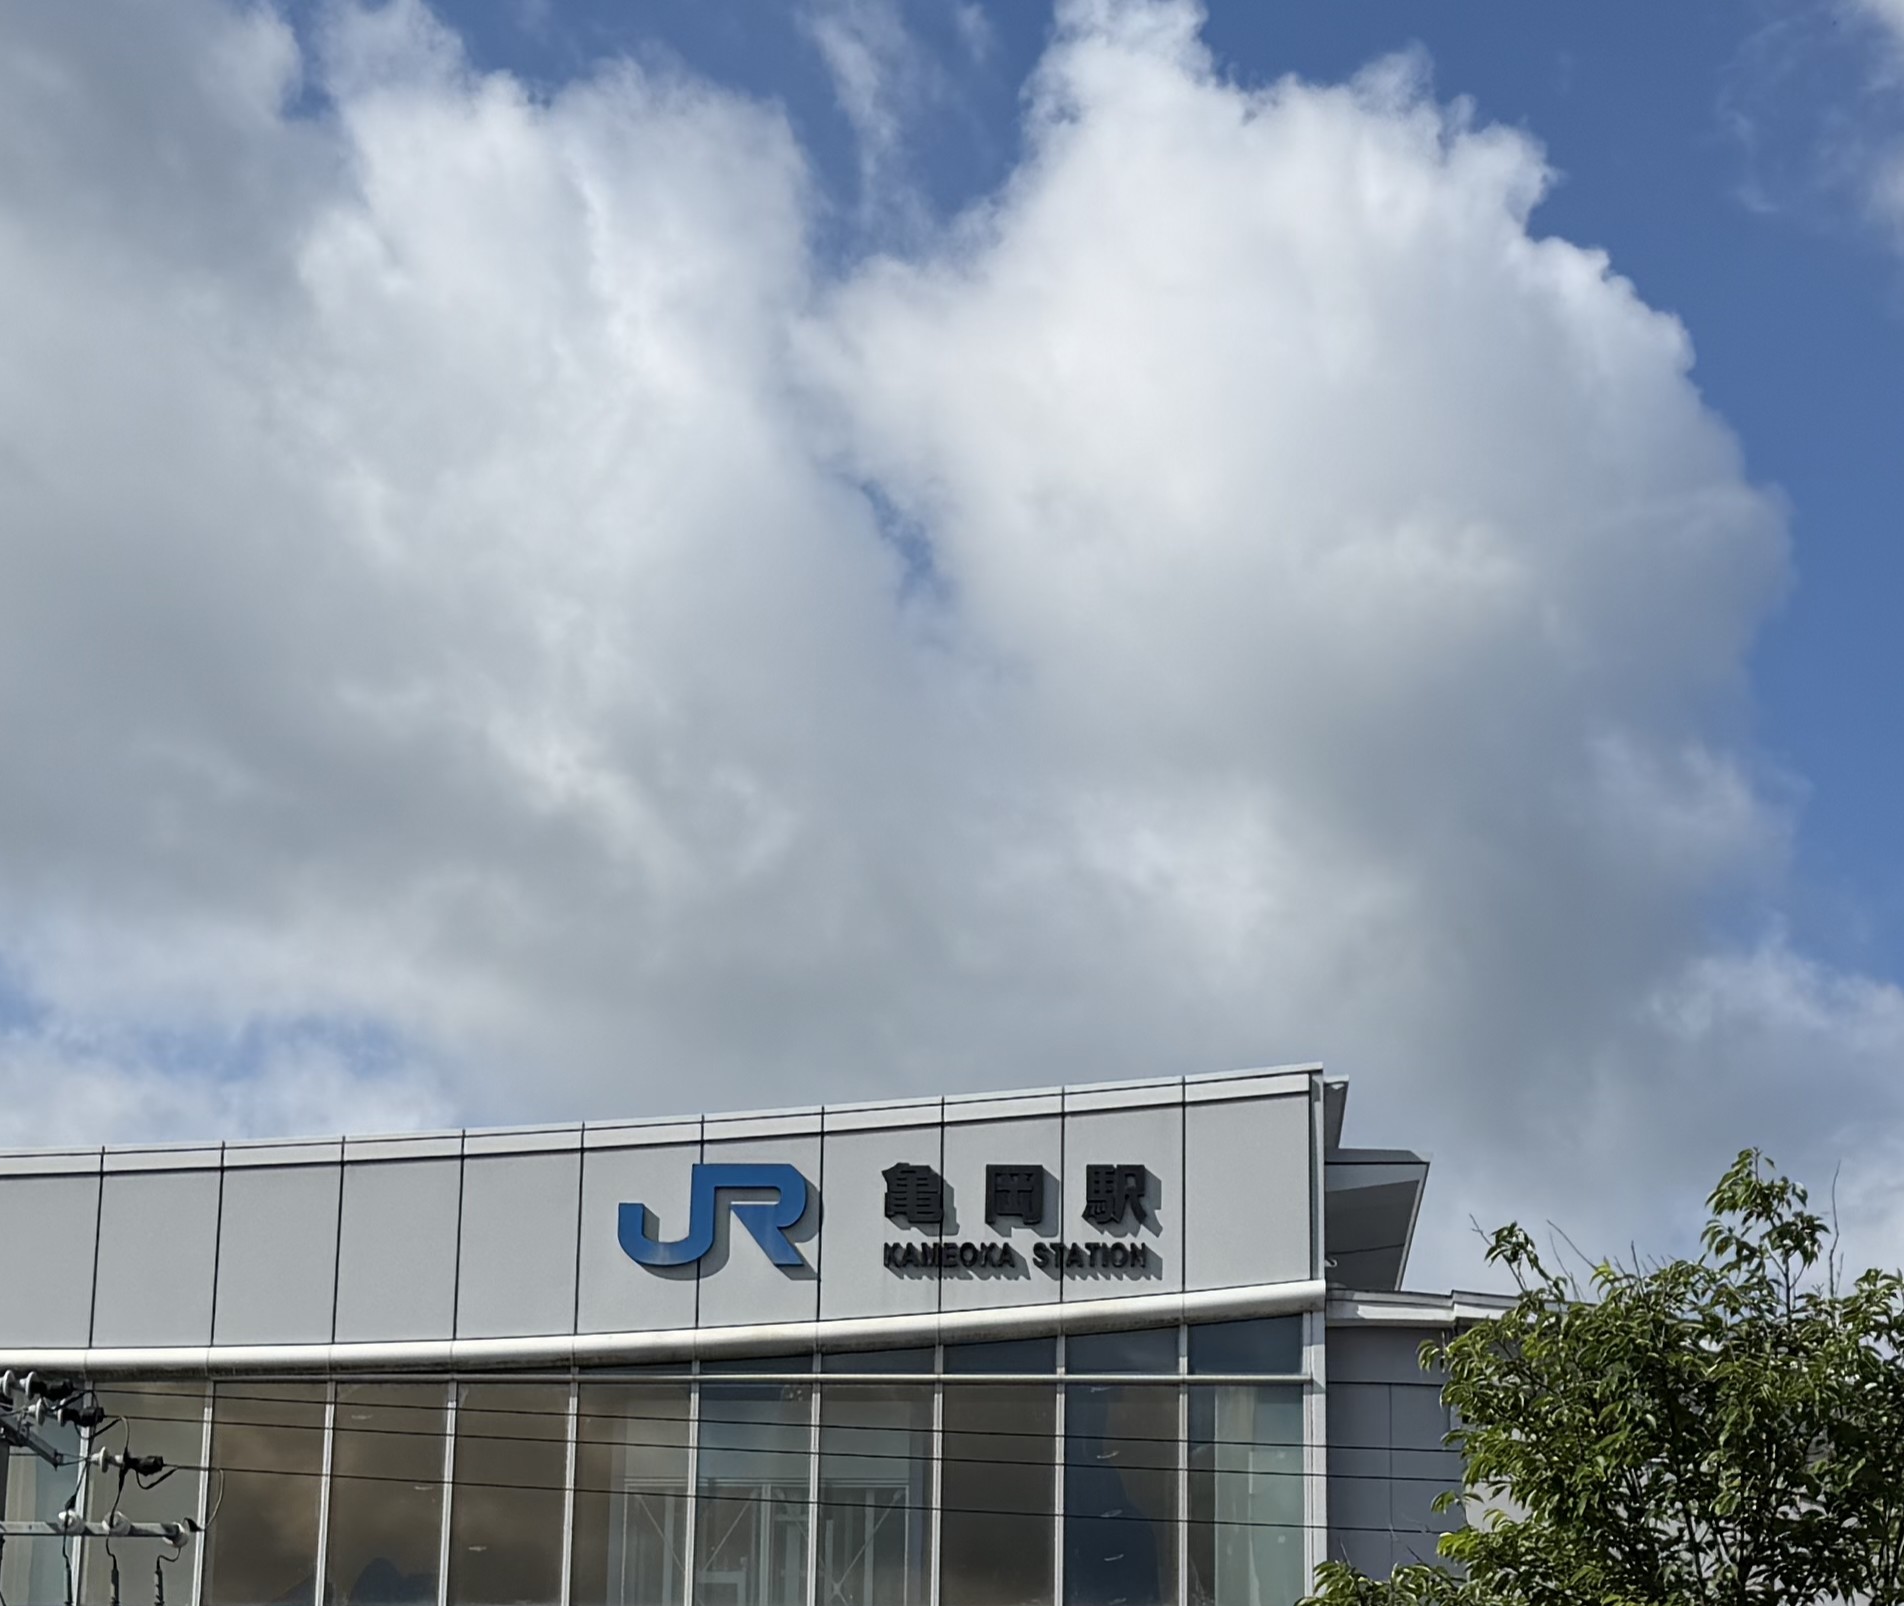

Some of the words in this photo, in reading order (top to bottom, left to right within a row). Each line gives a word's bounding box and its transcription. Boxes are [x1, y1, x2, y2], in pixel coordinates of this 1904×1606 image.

[618, 1163, 806, 1266] JR
[882, 1162, 1147, 1225] 亀岡駅
[883, 1242, 1015, 1269] KAMEOKA
[1033, 1242, 1146, 1269] STATION
